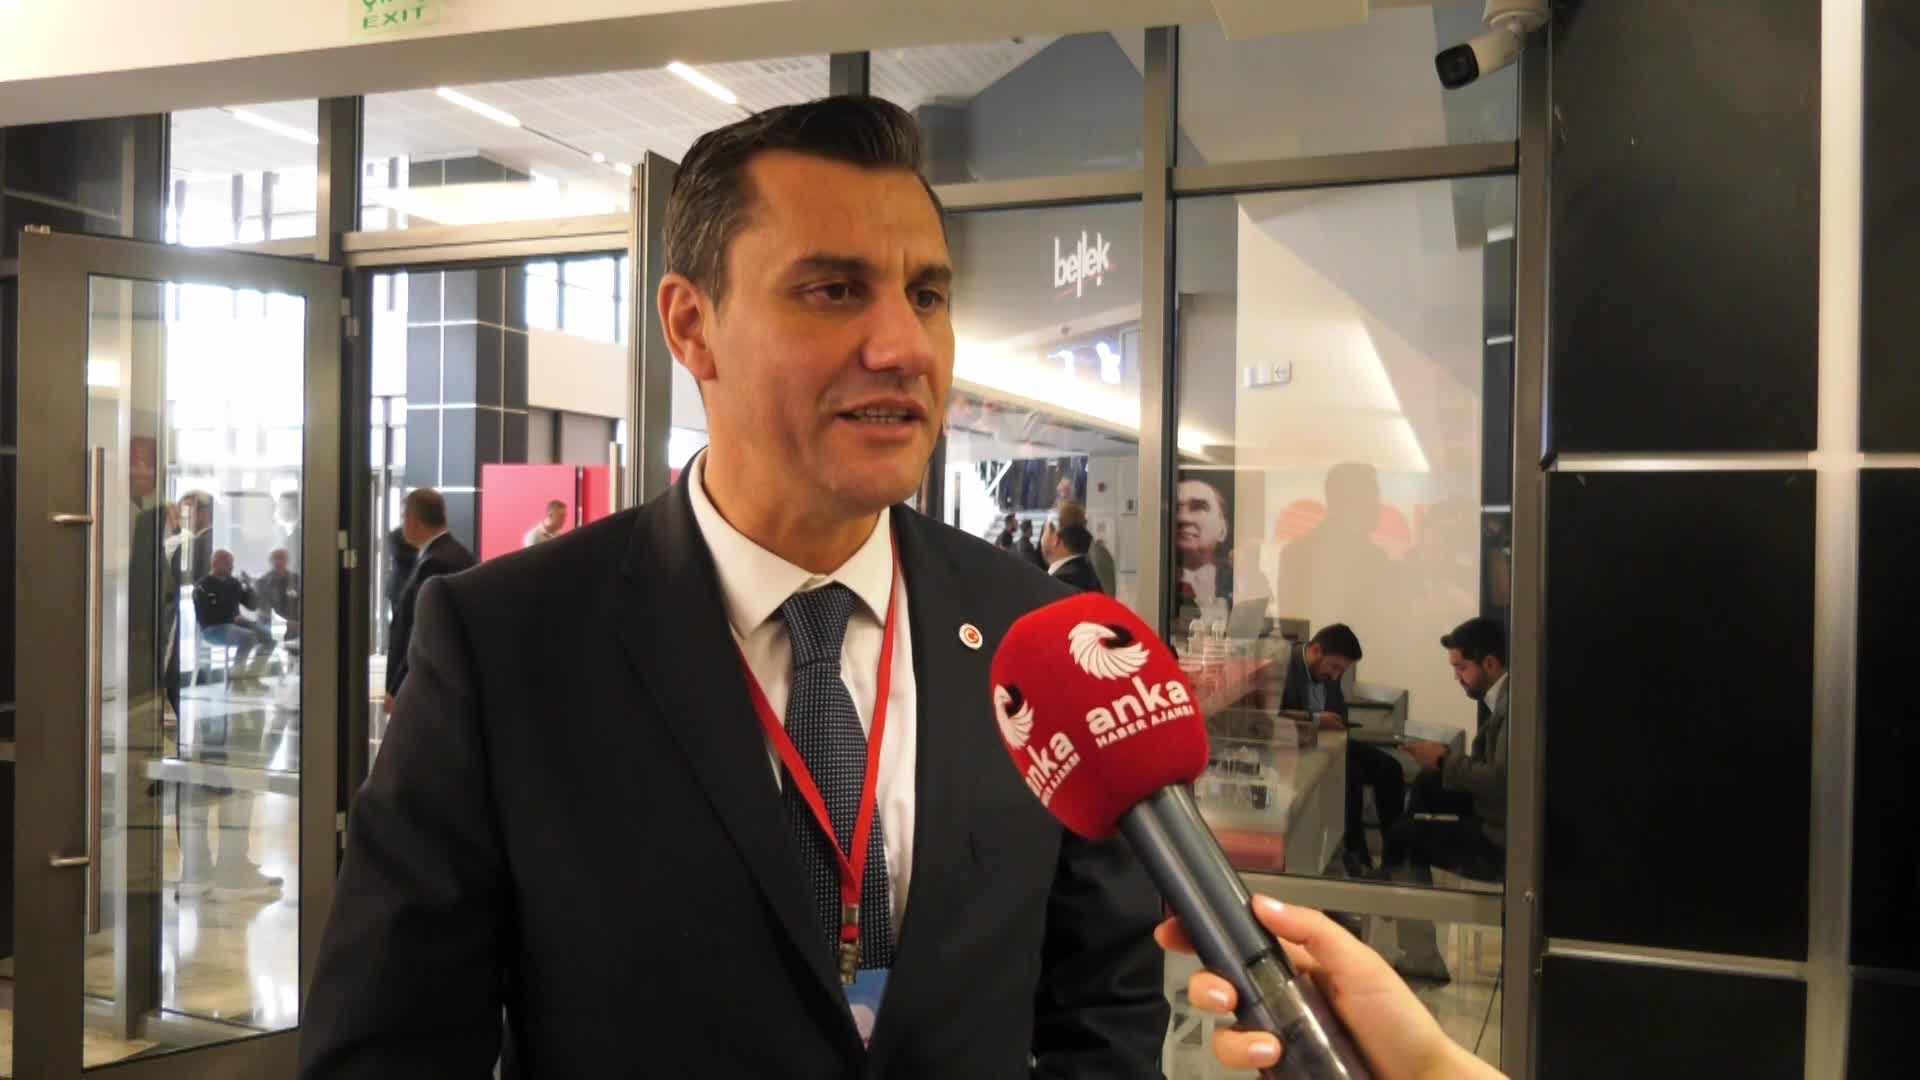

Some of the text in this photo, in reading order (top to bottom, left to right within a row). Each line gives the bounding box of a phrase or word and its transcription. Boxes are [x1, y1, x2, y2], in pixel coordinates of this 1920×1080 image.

[362, 6, 424, 30] EXIT
[1085, 676, 1190, 735] anka
[1095, 704, 1195, 748] HABER AJANSI
